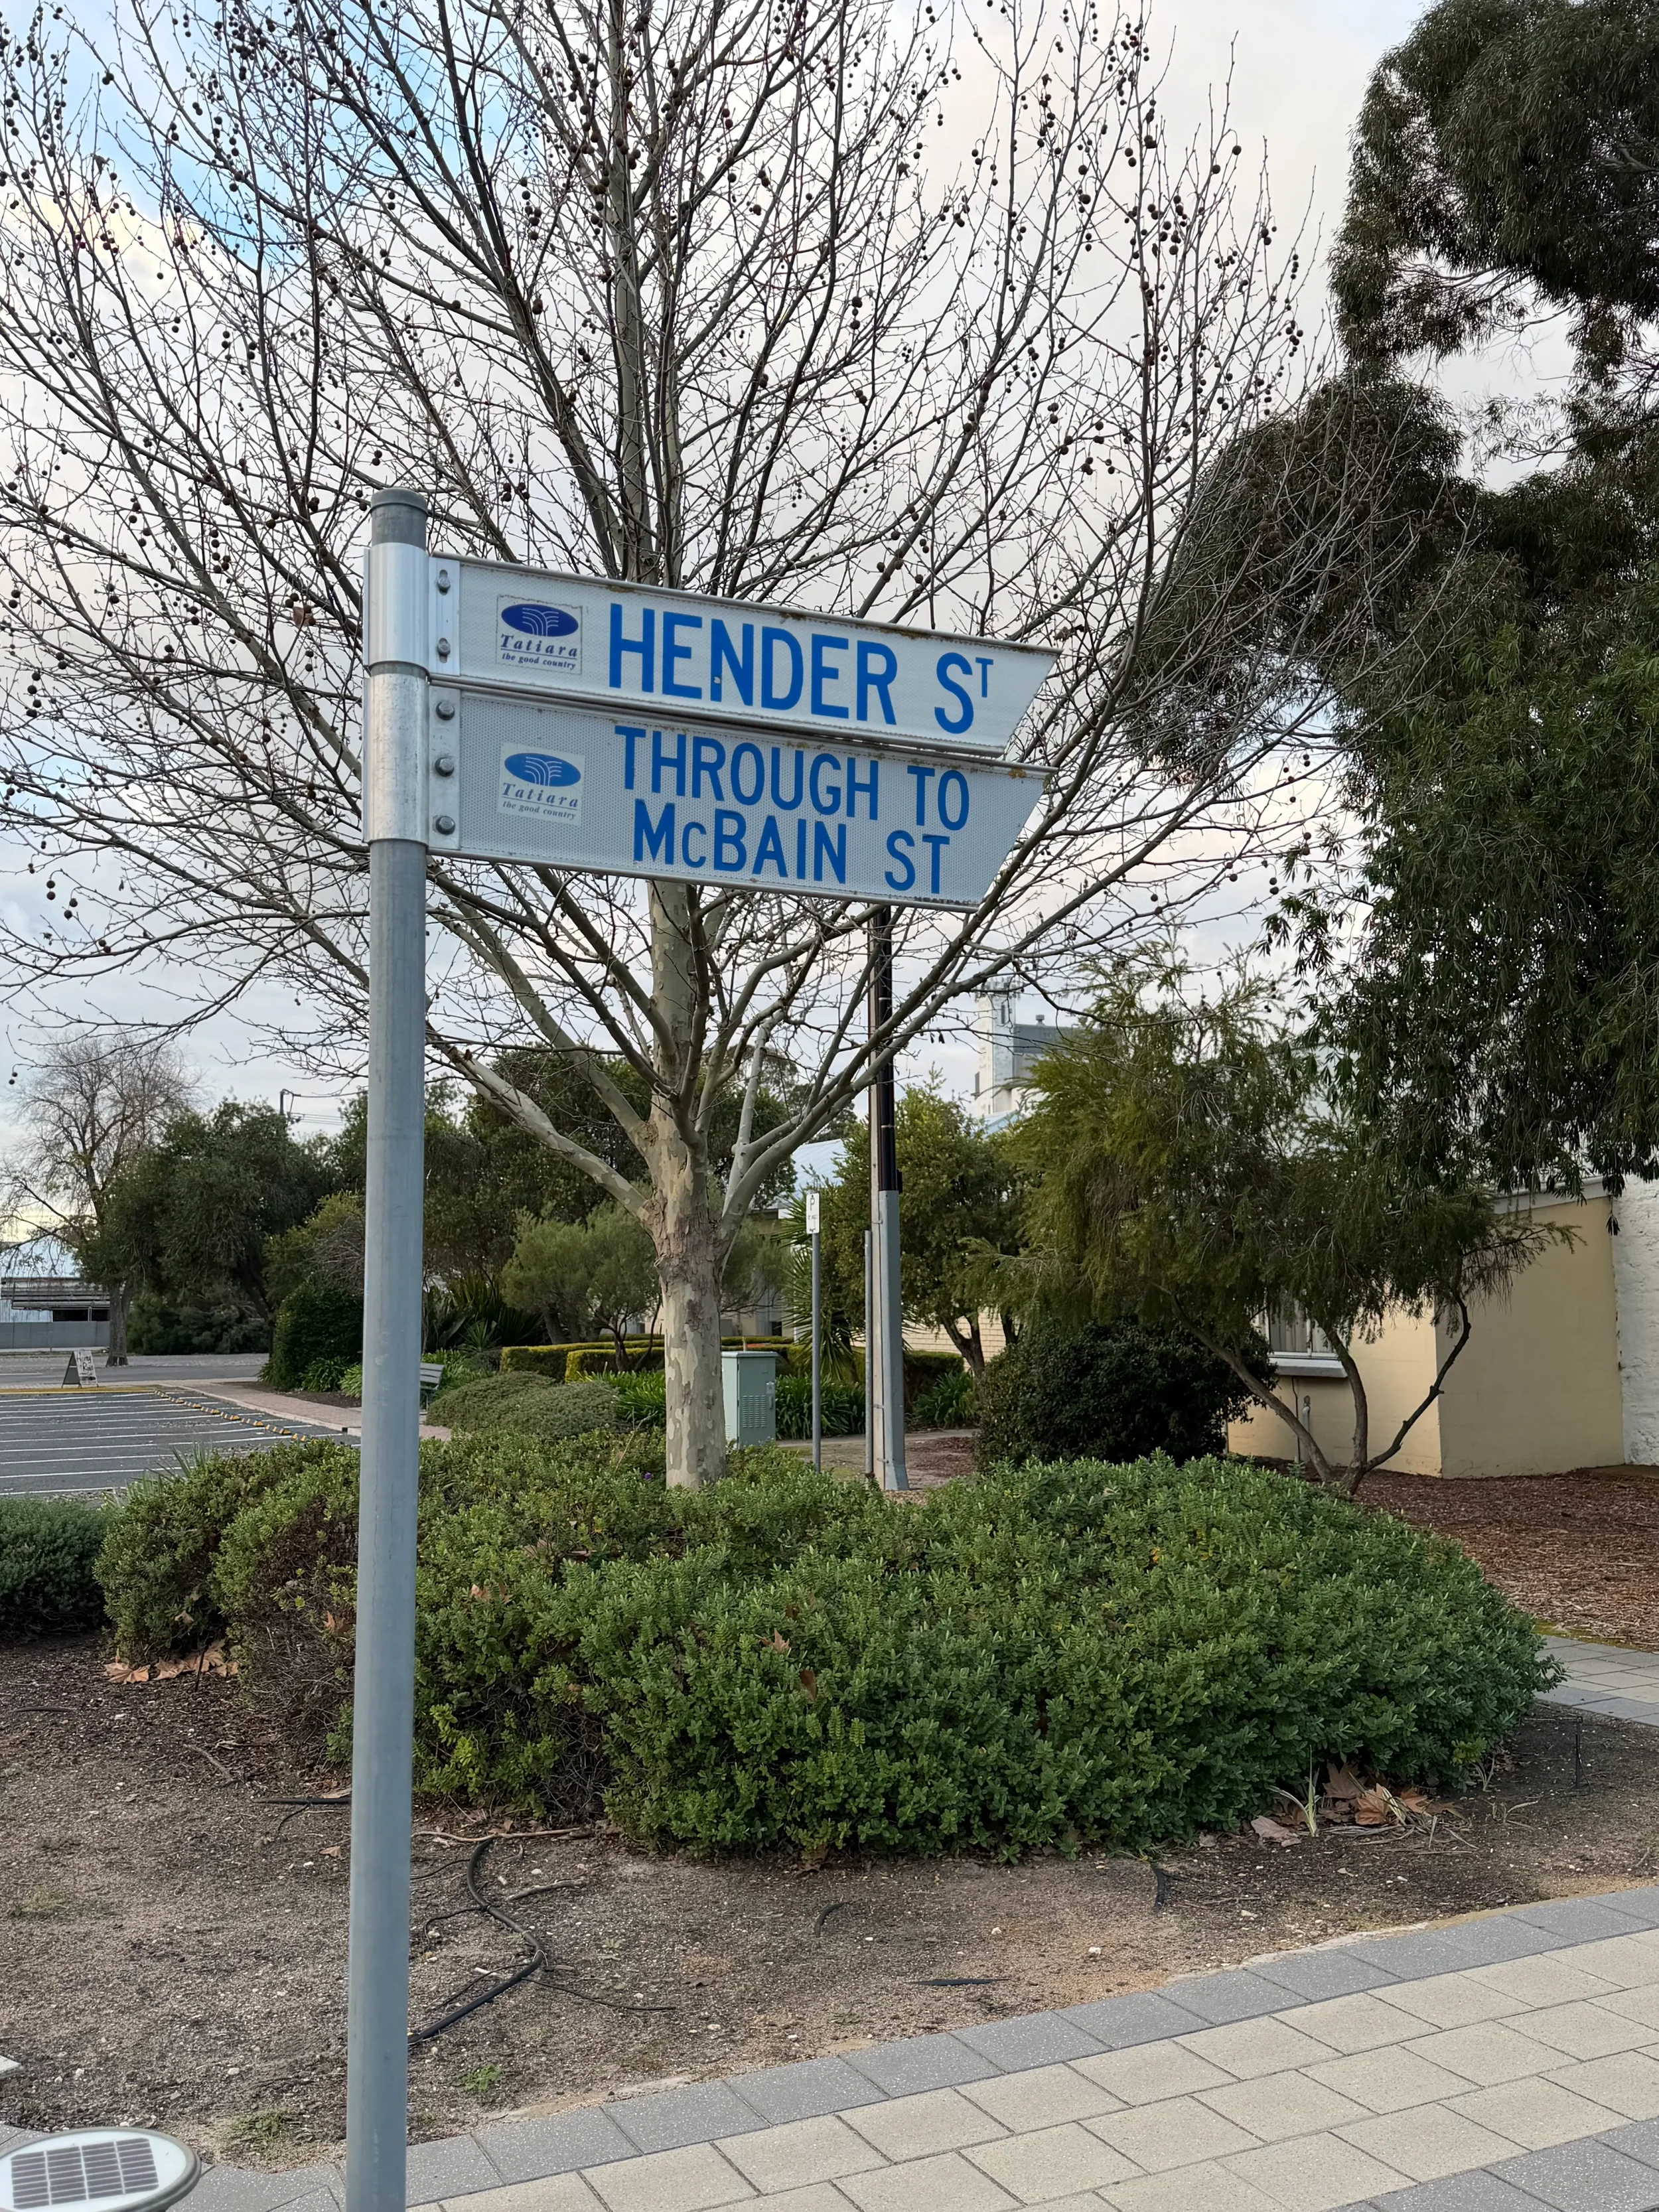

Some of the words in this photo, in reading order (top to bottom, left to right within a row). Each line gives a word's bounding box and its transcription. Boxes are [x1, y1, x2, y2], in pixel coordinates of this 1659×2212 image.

[500, 633, 578, 657] Tatiara
[543, 660, 576, 670] country
[609, 604, 898, 725] HENDER
[934, 652, 993, 735] ST
[614, 725, 879, 821] THROUGH
[907, 766, 970, 832] TO
[502, 782, 579, 808] Tatiara
[543, 809, 576, 820] country
[633, 798, 847, 885] McBAIN
[884, 830, 950, 894] ST
